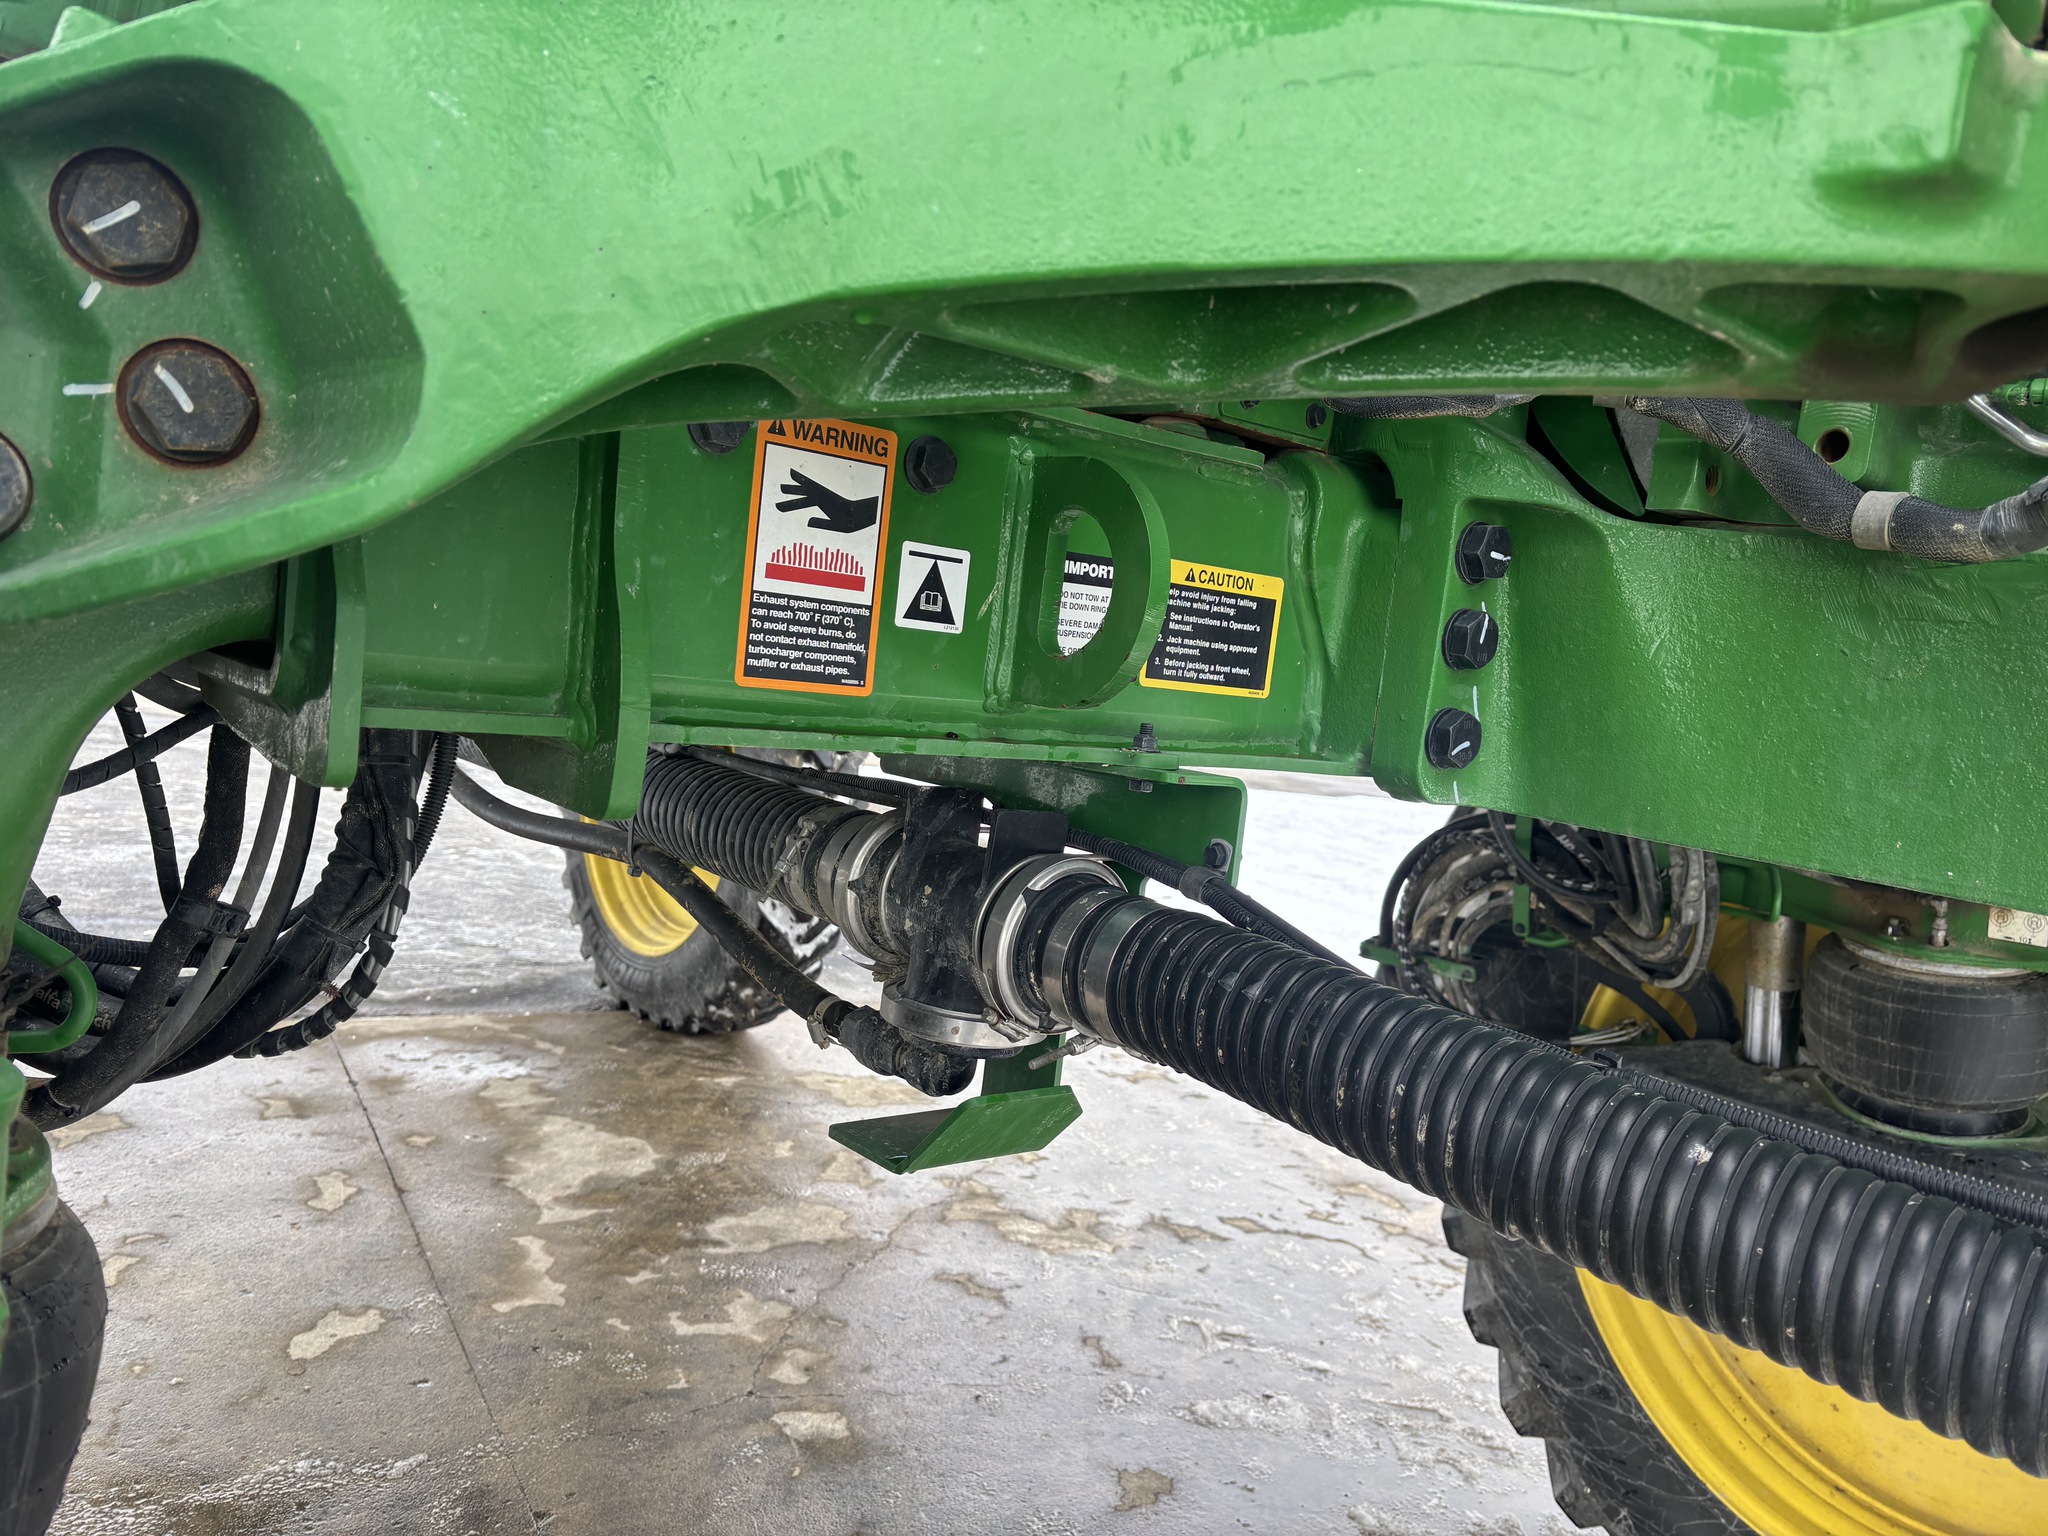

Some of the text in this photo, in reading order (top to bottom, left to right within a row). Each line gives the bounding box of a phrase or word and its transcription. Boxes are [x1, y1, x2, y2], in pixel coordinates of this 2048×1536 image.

[792, 419, 889, 458] WARNING
[1198, 569, 1254, 592] CAUTION
[753, 592, 870, 616] Exhaust system components
[1062, 590, 1110, 604] O NOT TOW AT
[1069, 602, 1090, 612] DOWN
[1169, 588, 1258, 610] elp avoid injury from falling
[751, 607, 855, 628] can reach 700° F (370° C).
[1192, 602, 1210, 611] while
[1210, 604, 1237, 616] jacking:
[750, 618, 856, 640] To avoid severe burns, do
[1060, 618, 1082, 628] EVERE
[1168, 622, 1194, 632] Manual.
[1170, 612, 1182, 621] See
[1183, 614, 1220, 627] instructions
[1222, 620, 1228, 628] in
[1229, 620, 1260, 632] Operator's
[750, 632, 866, 654] not contact exhaust manifold,
[1058, 629, 1094, 640] USPENSIO
[1157, 634, 1258, 654] 2. Jack machine using approved
[748, 644, 857, 665] turbocharger components,
[1166, 645, 1200, 656] equipment.
[747, 658, 850, 676] muffler or exhaust pipes.
[1154, 656, 1160, 665] 3.
[1164, 658, 1186, 668] Before
[1186, 660, 1210, 673] jacking
[1216, 664, 1230, 673] front
[1231, 666, 1250, 677] wheel,
[1164, 668, 1226, 682] turn it fully outward.
